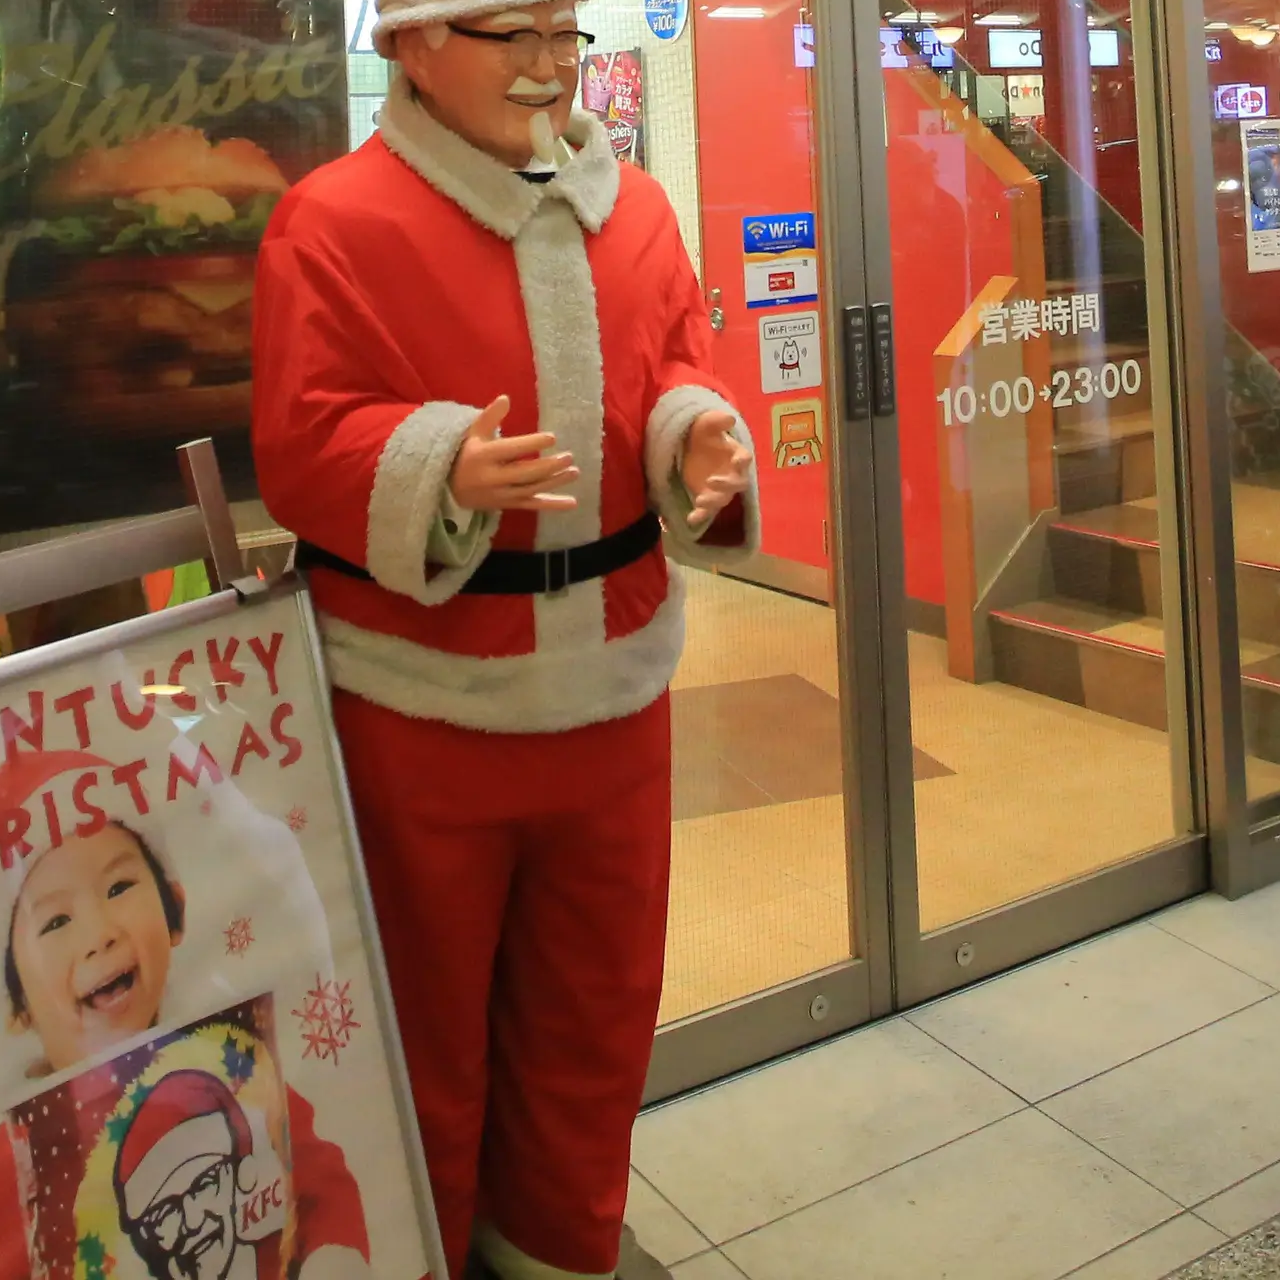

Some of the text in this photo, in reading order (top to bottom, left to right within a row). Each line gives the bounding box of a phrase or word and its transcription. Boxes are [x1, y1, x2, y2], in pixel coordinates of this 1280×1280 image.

[768, 220, 808, 239] Wi-Fi
[978, 293, 1101, 348] 営業時間
[937, 359, 1142, 427] 10:00 23:00
[241, 1176, 283, 1233] KFC
